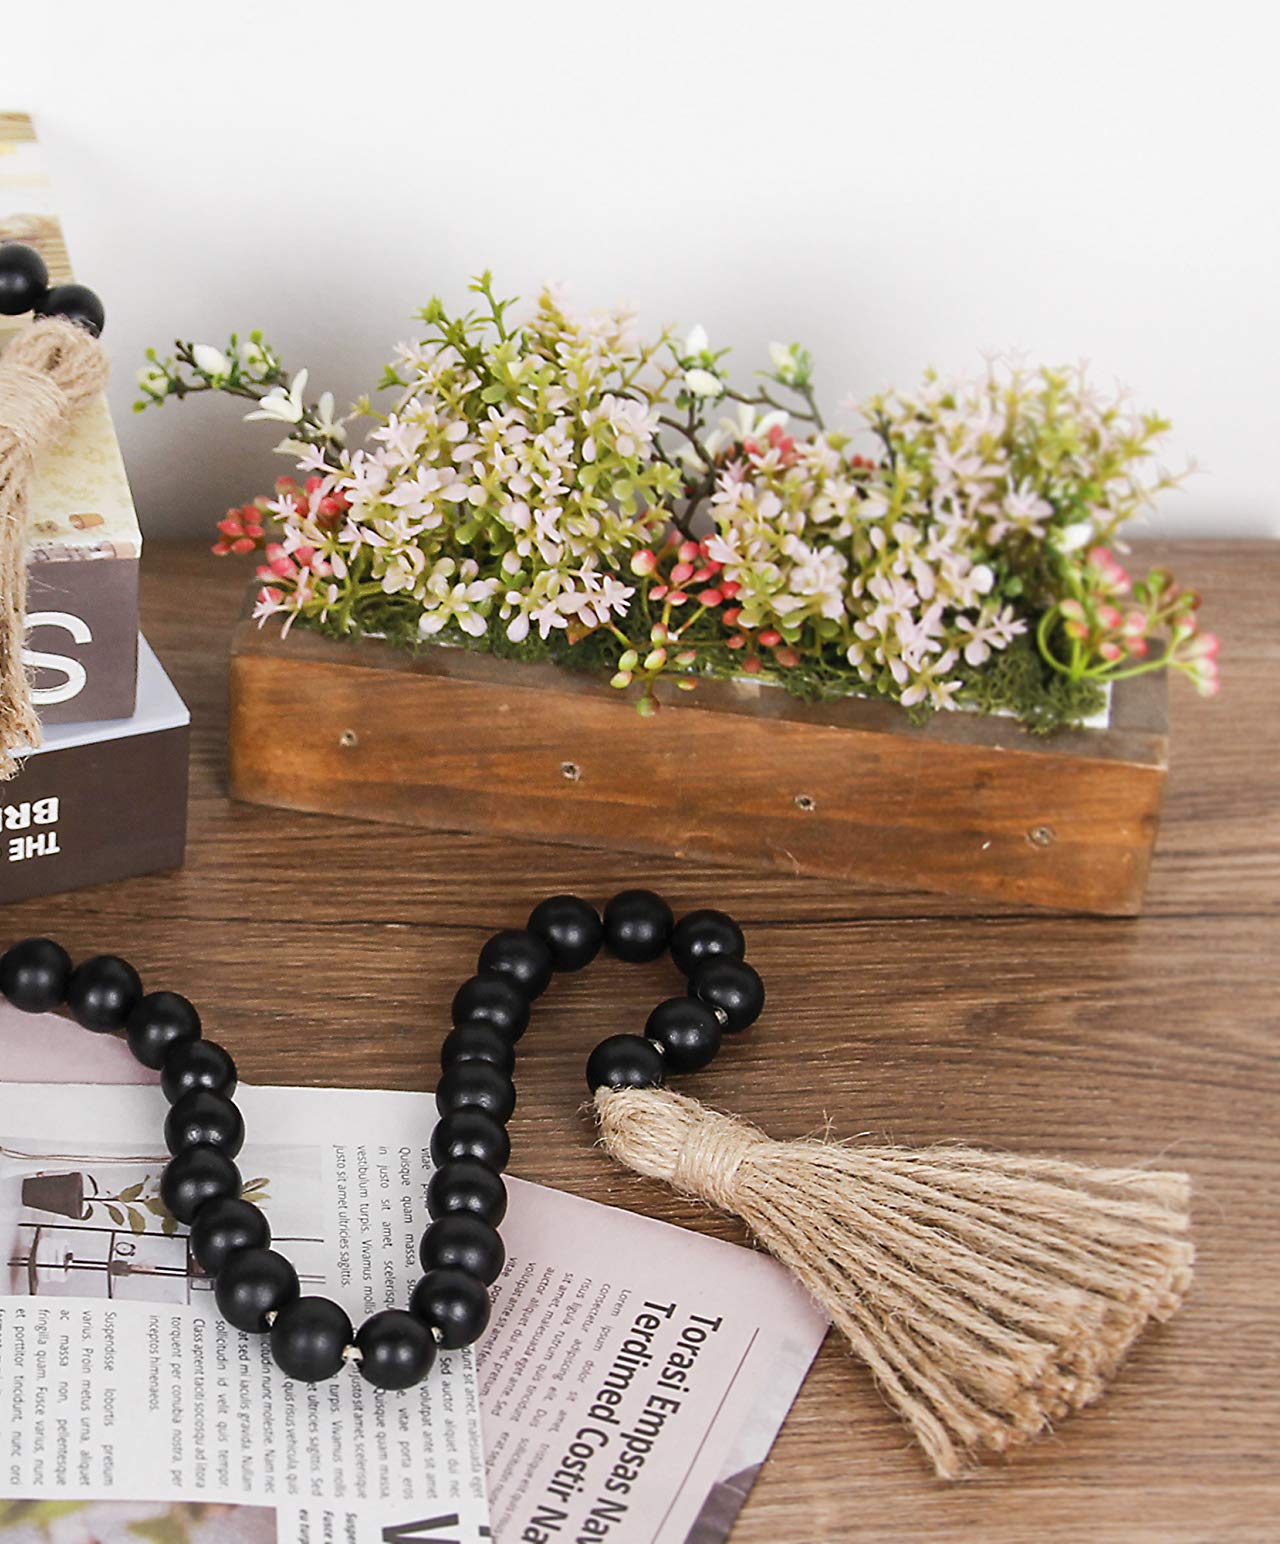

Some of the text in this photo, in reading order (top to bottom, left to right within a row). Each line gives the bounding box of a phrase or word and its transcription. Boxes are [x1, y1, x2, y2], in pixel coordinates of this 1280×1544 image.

[9, 832, 60, 862] THE
[333, 1144, 353, 1287] justo sit amet ultricies sagittis.
[398, 1146, 416, 1267] Quisque quam massa,
[356, 1144, 377, 1318] vestibulum turpis. Vivamus mollis
[536, 1266, 556, 1295] auctor
[562, 1272, 574, 1284] sit
[576, 1277, 594, 1299] risus
[16, 1307, 27, 1317] et
[34, 1308, 51, 1345] fringilla
[60, 1308, 70, 1320] ac
[517, 1296, 540, 1326] aliquet
[12, 1325, 26, 1367] porttitor
[146, 1314, 161, 1354] inceptos
[510, 1328, 524, 1343] dui
[523, 1310, 555, 1357] malesuada
[544, 1329, 567, 1361] rutrum
[59, 1334, 70, 1366] massa
[81, 1347, 95, 1373] Proin
[499, 1344, 514, 1361] nec
[513, 1356, 529, 1376] eget
[587, 1301, 678, 1426] Terdimed
[657, 1314, 723, 1394] Torasi
[532, 1363, 548, 1381] quis
[35, 1386, 49, 1415] Fusce
[80, 1379, 93, 1411] metus
[101, 1311, 118, 1486] Suspendisse lobortis pretium
[491, 1399, 509, 1416] Sed
[509, 1384, 538, 1422] tincidunt
[11, 1430, 22, 1456] nunc
[54, 1418, 70, 1485] pellentesque
[605, 1394, 682, 1495] Empsas
[10, 1464, 22, 1485] orci
[33, 1458, 45, 1485] nunc
[78, 1449, 93, 1486] aliquet
[547, 1427, 610, 1503] Costir
